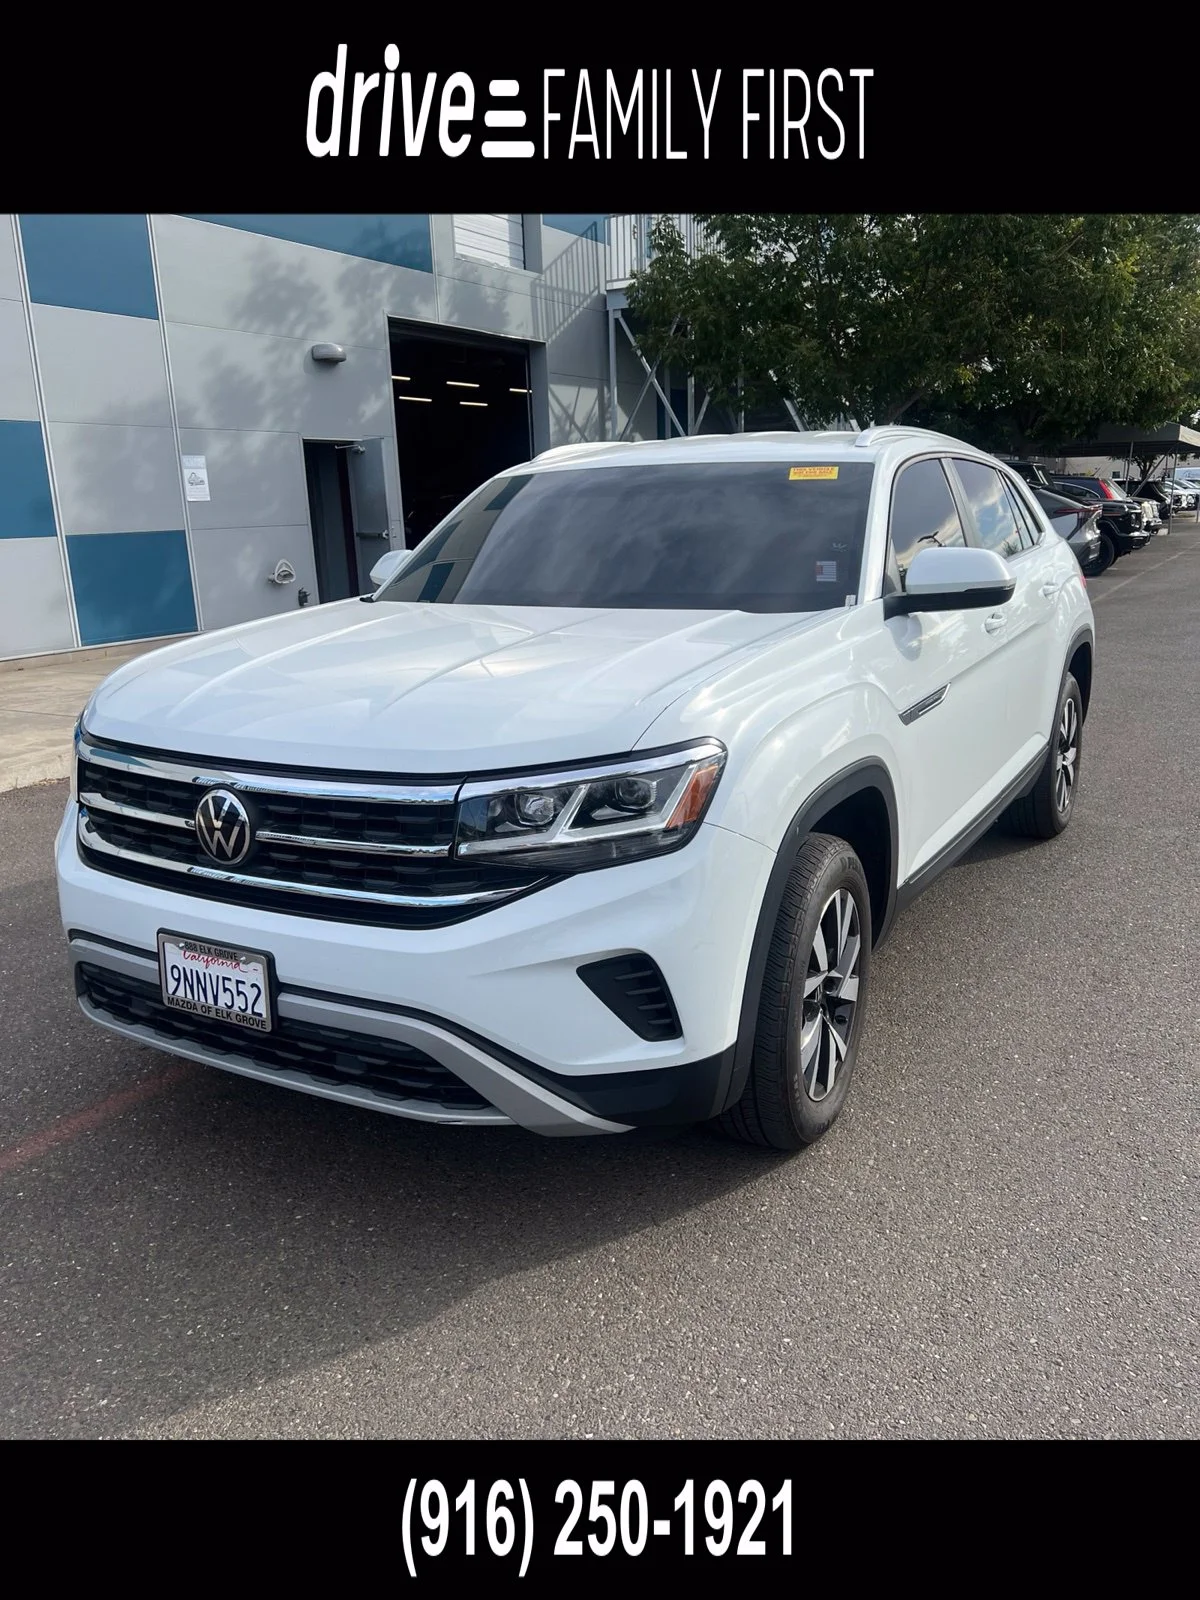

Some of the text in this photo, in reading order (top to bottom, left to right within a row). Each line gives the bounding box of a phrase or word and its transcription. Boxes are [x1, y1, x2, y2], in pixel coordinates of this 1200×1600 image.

[200, 944, 212, 954] ELK
[215, 948, 239, 960] GROVE
[170, 964, 263, 1018] 9NNV552
[167, 996, 267, 1030] MAZDA OF ELK GROVE
